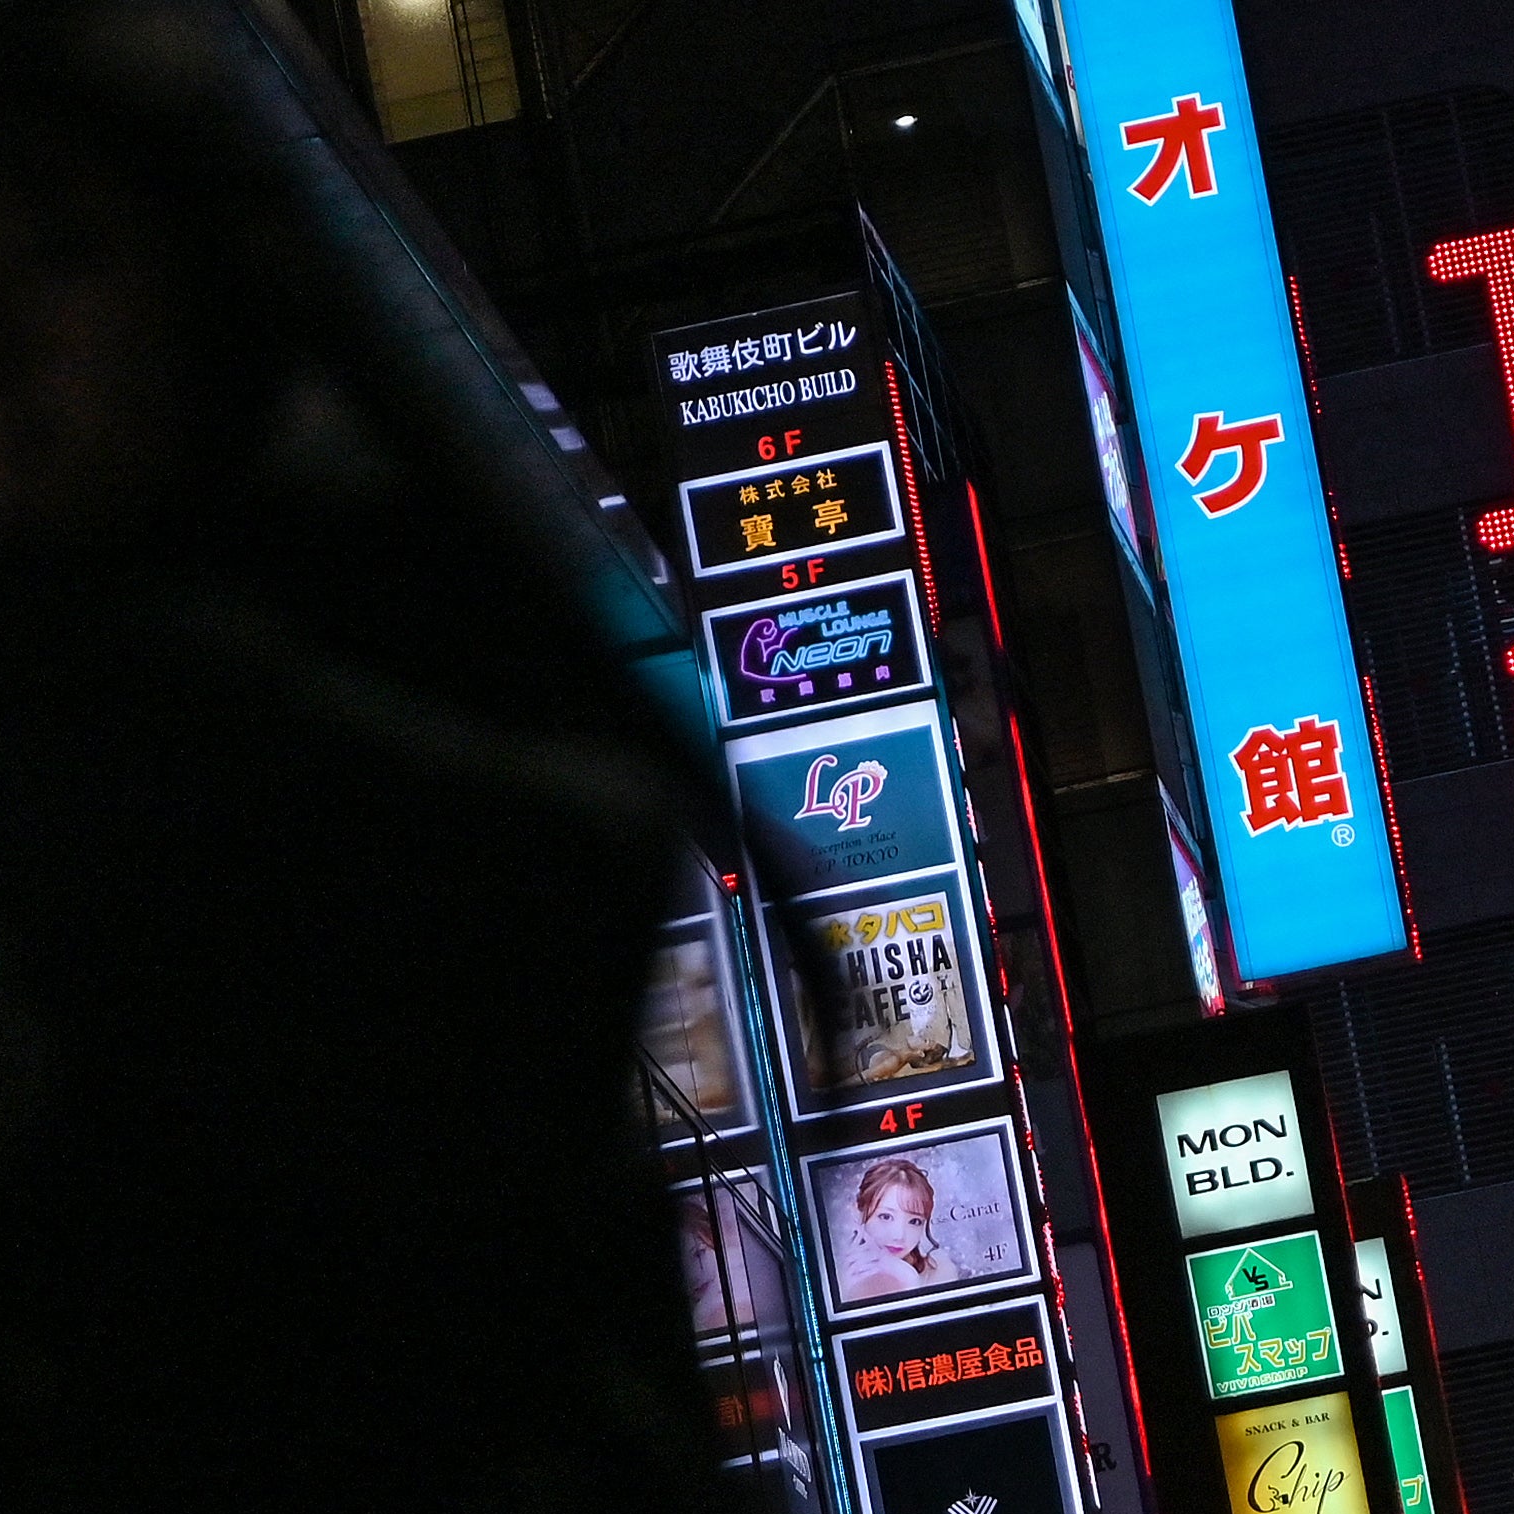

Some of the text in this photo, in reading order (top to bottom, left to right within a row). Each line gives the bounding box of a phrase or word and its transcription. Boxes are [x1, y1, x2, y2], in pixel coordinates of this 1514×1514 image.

[668, 320, 857, 382] 歌舞伎町ビル
[680, 368, 856, 425] KABUKICHO BUILD
[739, 469, 838, 505] 株式会社
[778, 601, 850, 628] MUSCLE
[822, 610, 891, 637] LOUNGE
[843, 845, 899, 868] TOKYO
[846, 934, 951, 989] HISHA
[855, 983, 910, 1029] AFE
[880, 1103, 924, 1133] 4F
[1177, 1115, 1288, 1158] MON
[1186, 1157, 1295, 1196] BLD.
[1203, 1311, 1257, 1349] ビバ
[1235, 1327, 1332, 1375] スマップ
[1217, 1367, 1309, 1393] VIVASMAP
[1245, 1411, 1331, 1437] SNACK & BAR
